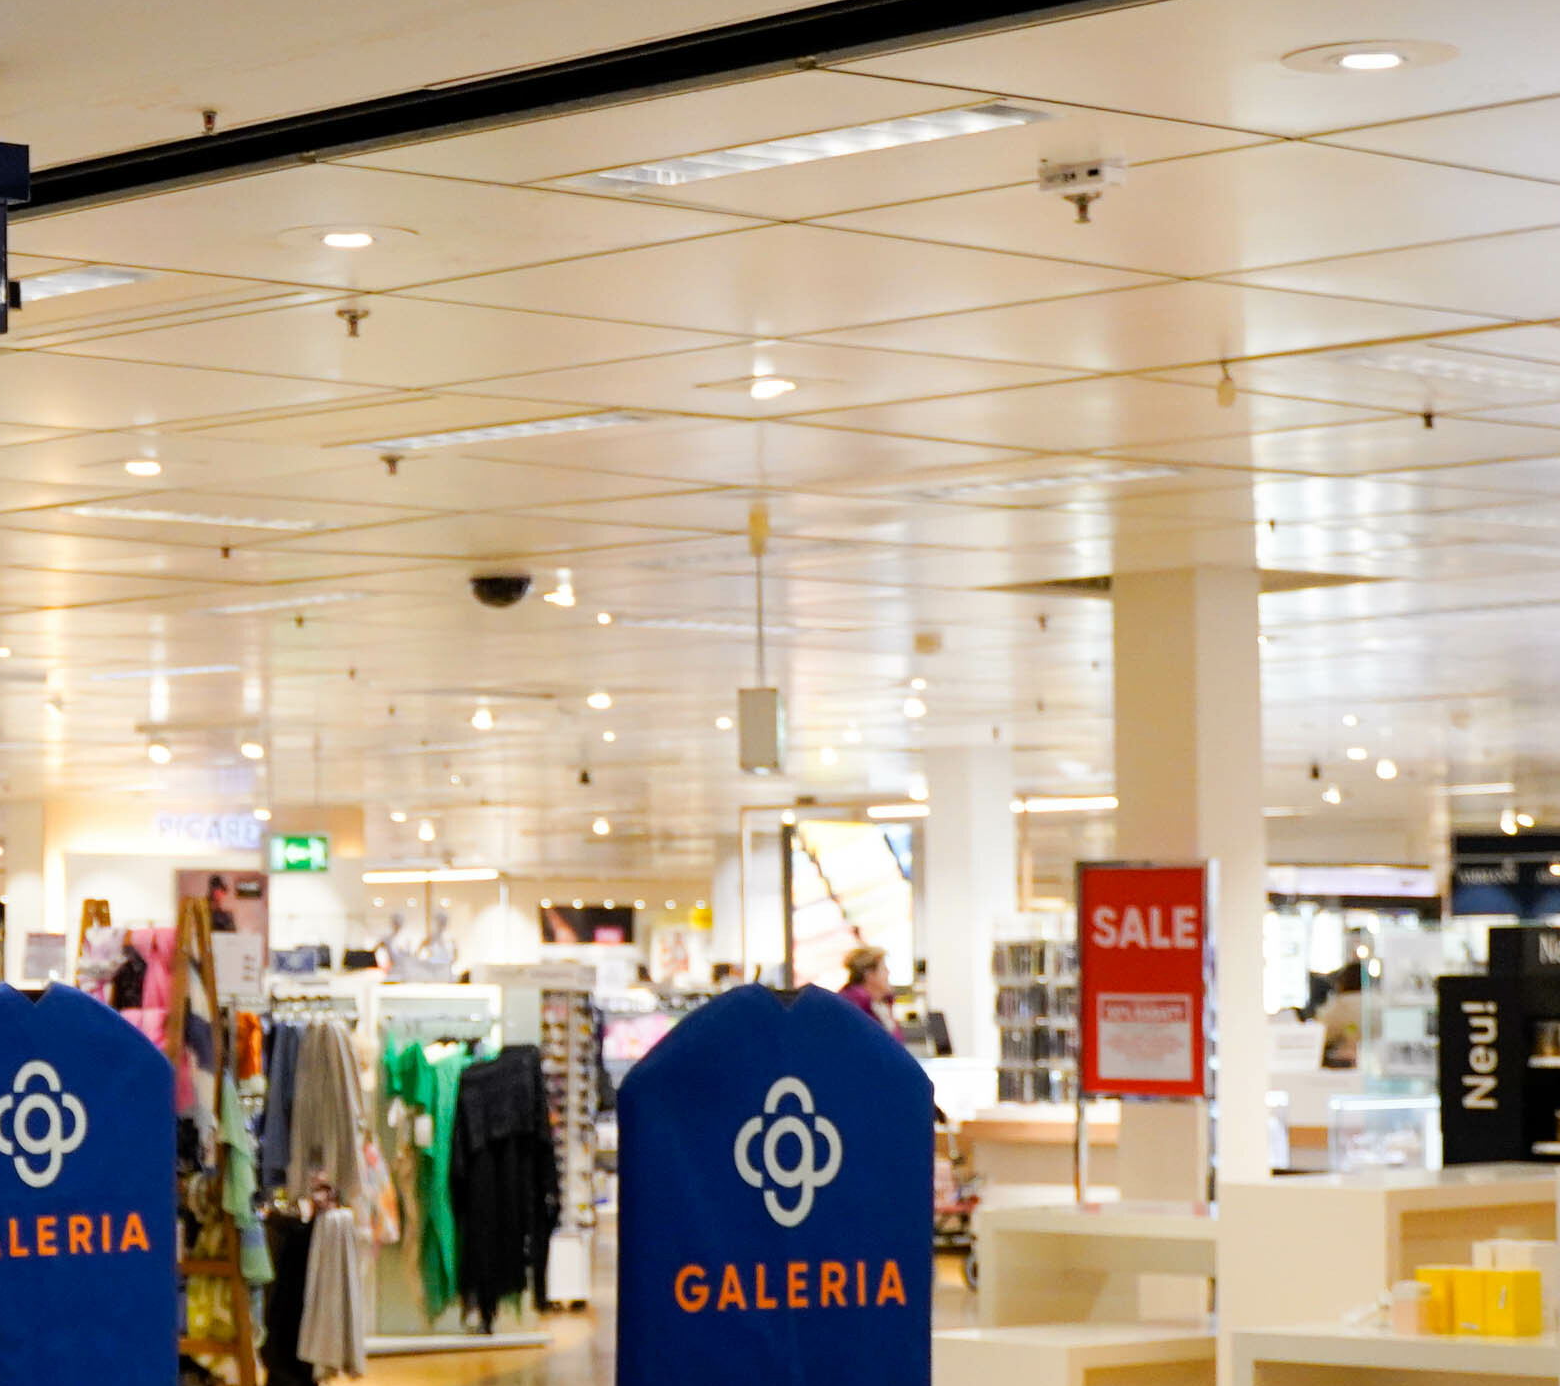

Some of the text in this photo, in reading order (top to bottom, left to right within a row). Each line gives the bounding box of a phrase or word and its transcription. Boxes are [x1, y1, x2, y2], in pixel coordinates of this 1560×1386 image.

[1091, 905, 1198, 950] SALE
[1460, 1000, 1499, 1110] Neu!
[674, 1259, 907, 1314] GALERIA
